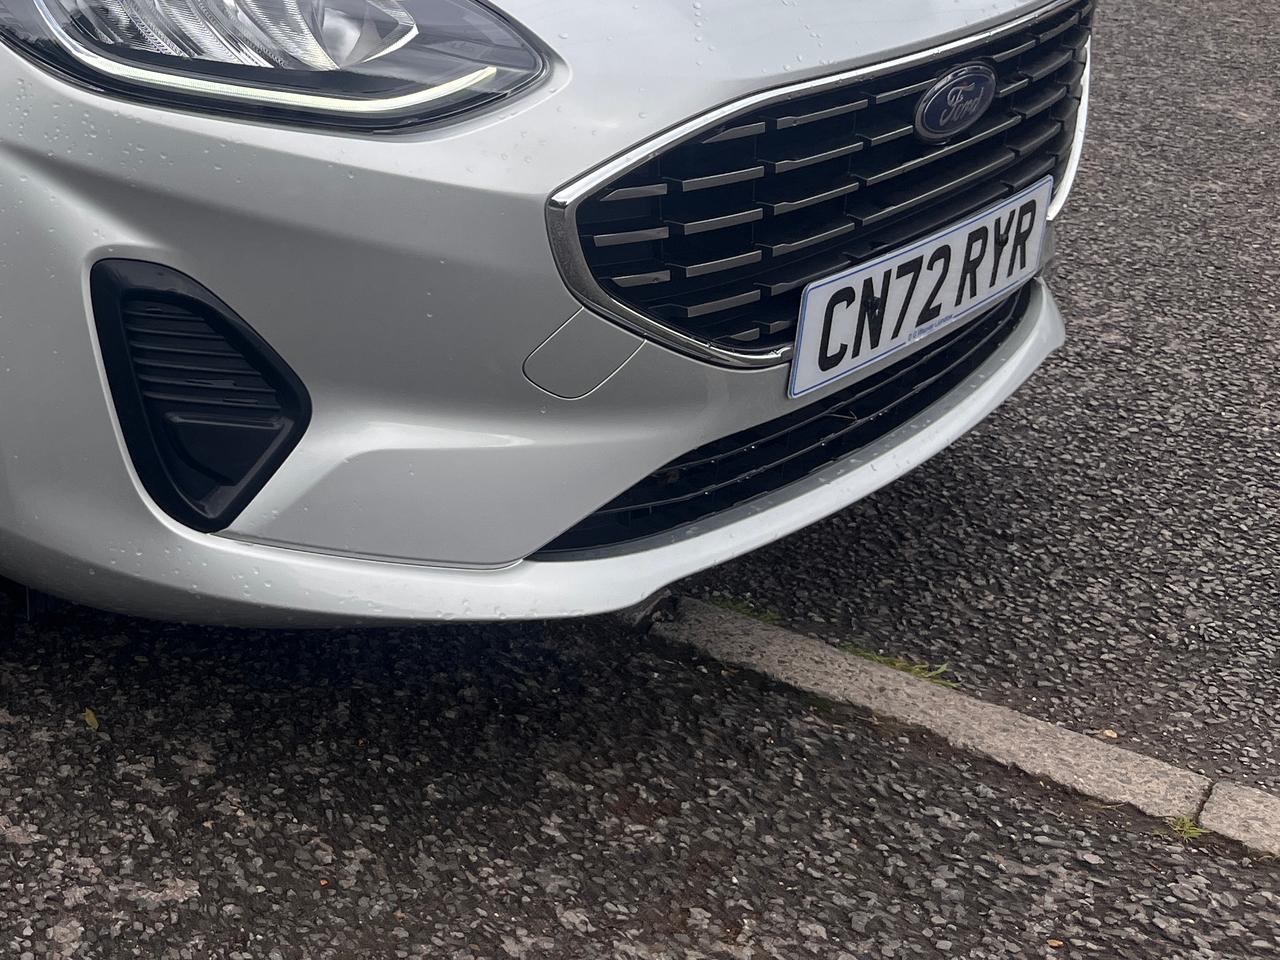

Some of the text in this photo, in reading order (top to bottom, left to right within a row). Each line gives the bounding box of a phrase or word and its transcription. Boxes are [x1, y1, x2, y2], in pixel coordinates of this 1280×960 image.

[939, 82, 984, 126] Ford
[818, 199, 1037, 372] CN72 RYR
